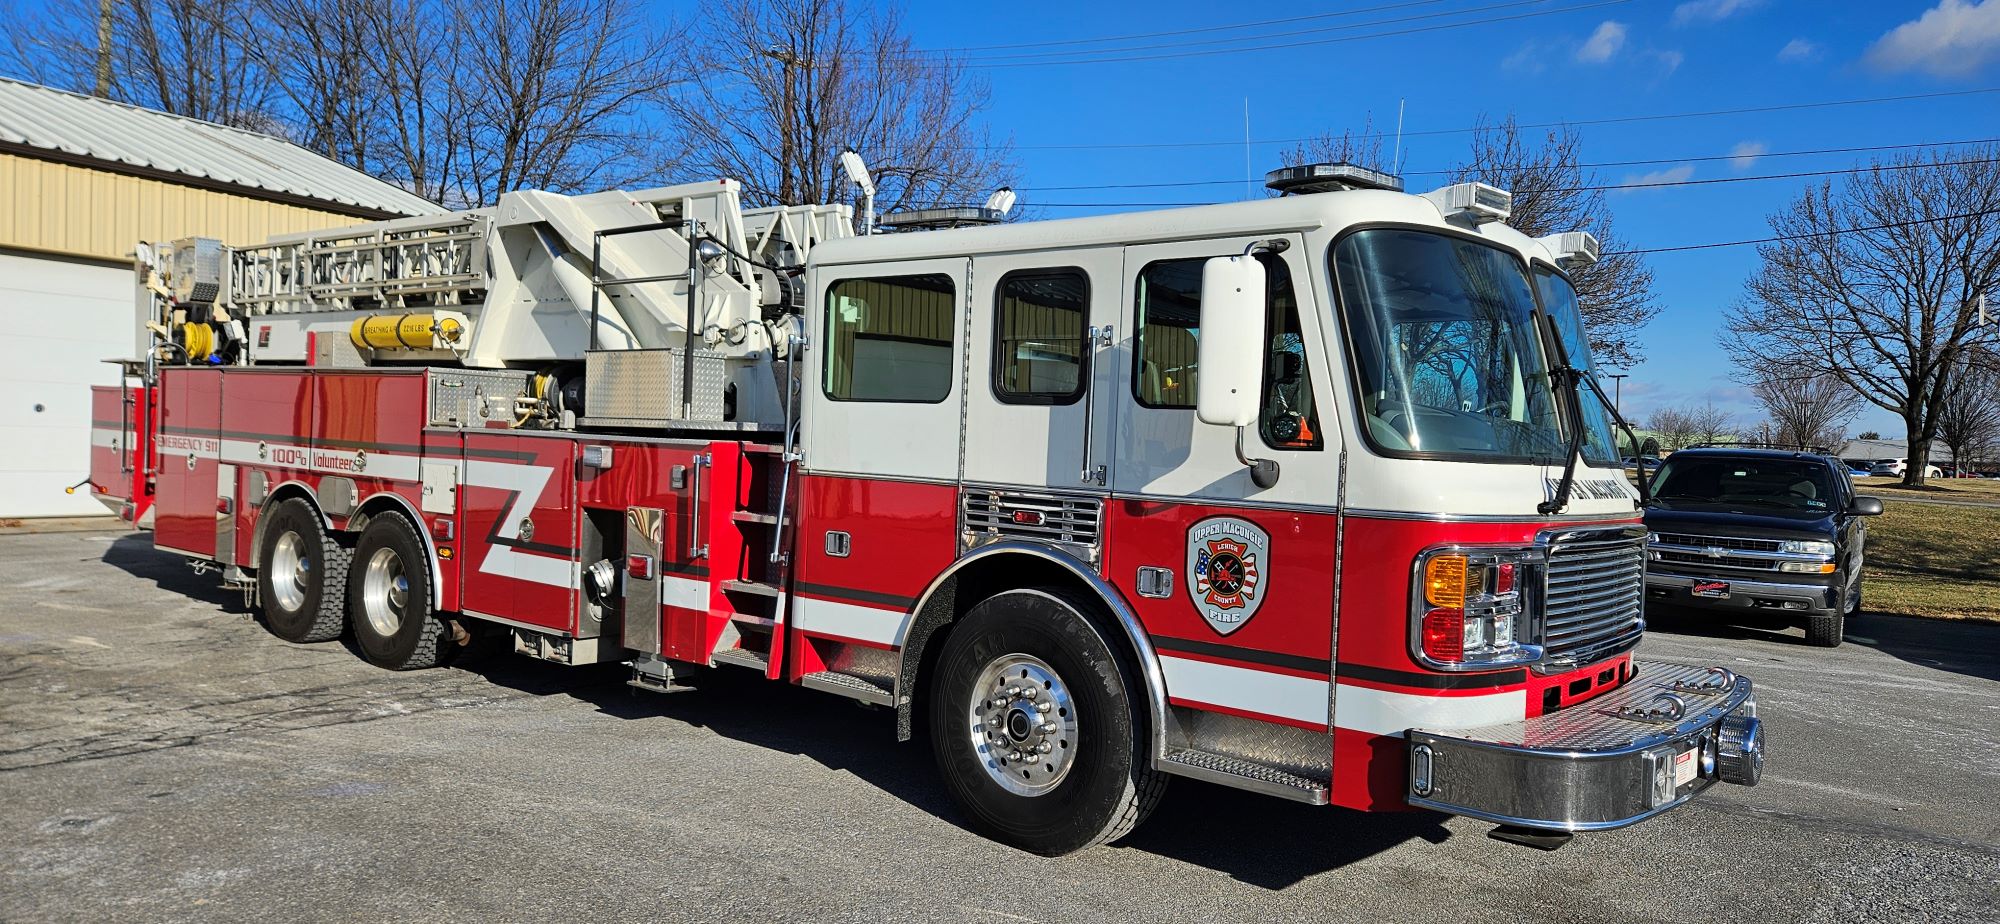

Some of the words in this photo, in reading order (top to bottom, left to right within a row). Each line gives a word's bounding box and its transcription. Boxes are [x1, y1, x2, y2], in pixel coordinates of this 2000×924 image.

[158, 436, 202, 451] EMERGENCY
[205, 440, 218, 453] 911
[272, 448, 307, 466] 100%
[1194, 522, 1221, 543] UPPER
[1222, 522, 1263, 550] MACUNGIE
[1217, 543, 1239, 552] LEHIGH
[1213, 594, 1238, 604] COUNTY
[1208, 608, 1241, 623] FIRE
